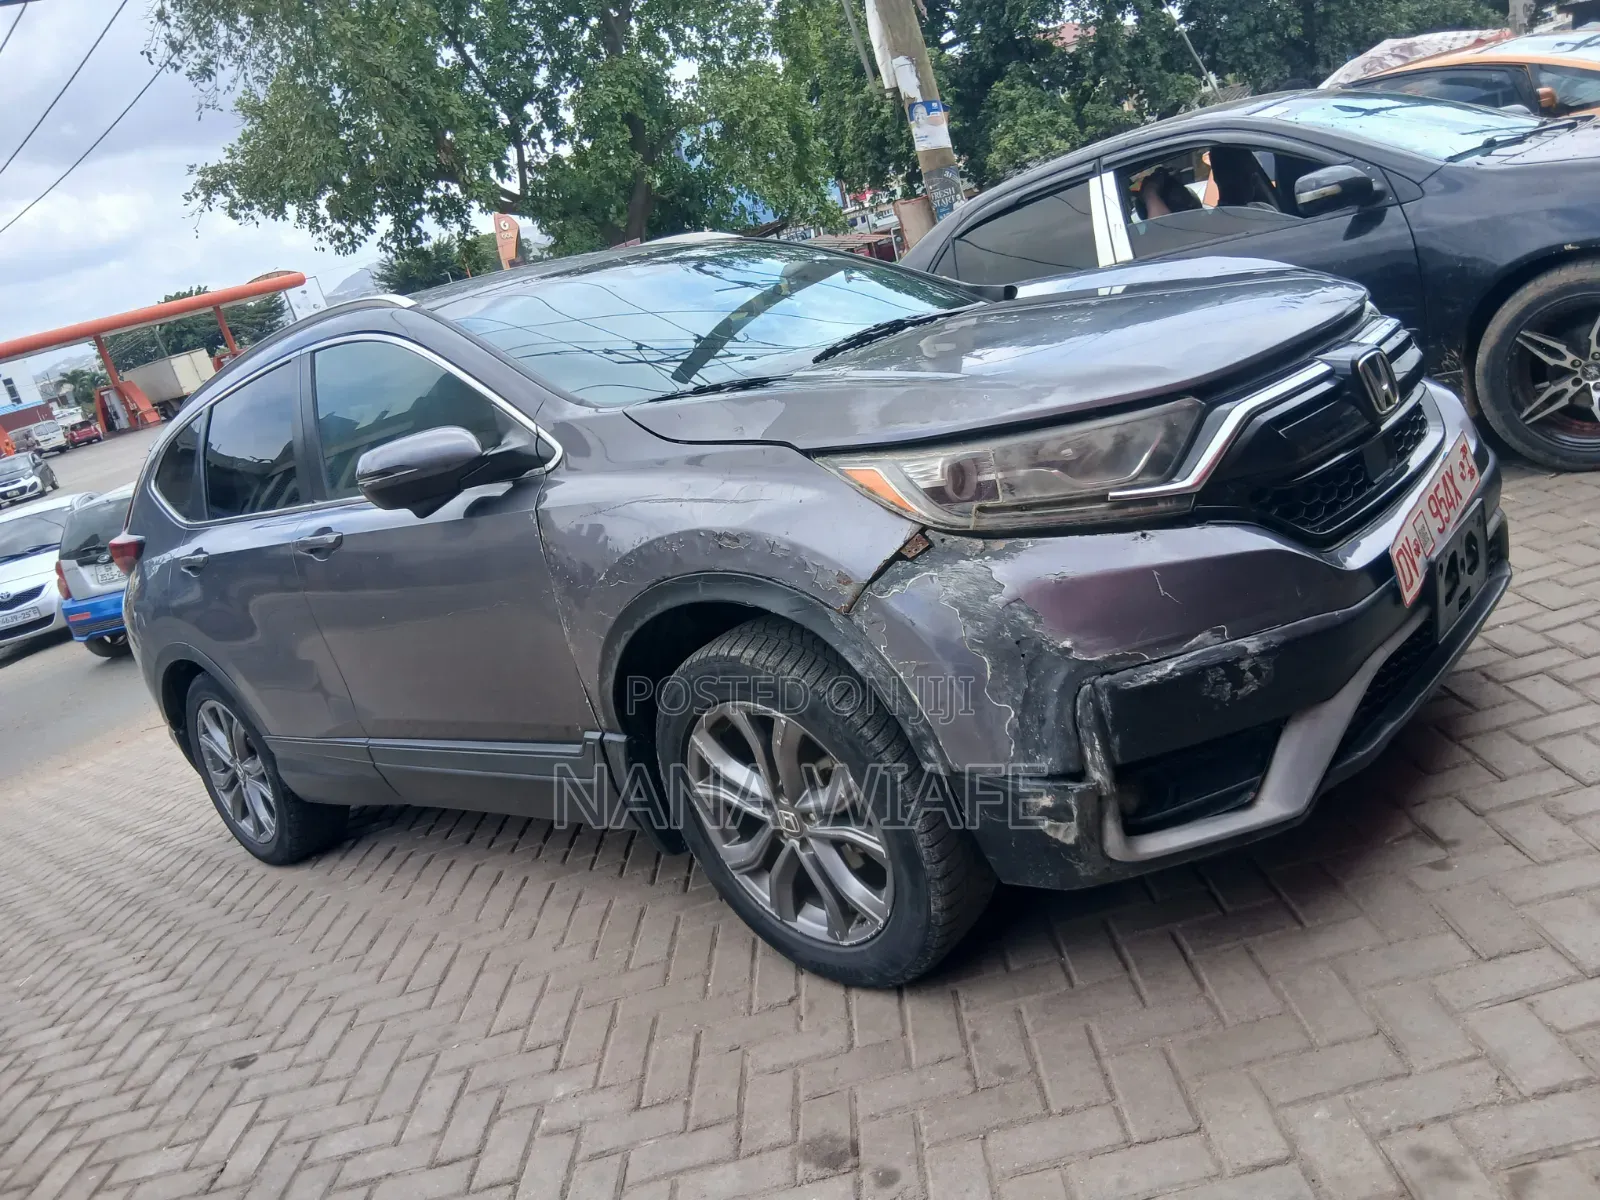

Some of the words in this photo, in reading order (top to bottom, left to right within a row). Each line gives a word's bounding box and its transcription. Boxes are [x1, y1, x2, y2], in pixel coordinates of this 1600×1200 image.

[931, 187, 955, 200] FRESH
[933, 195, 955, 207] START
[1395, 536, 1420, 593] DV
[1427, 463, 1463, 534] 954X
